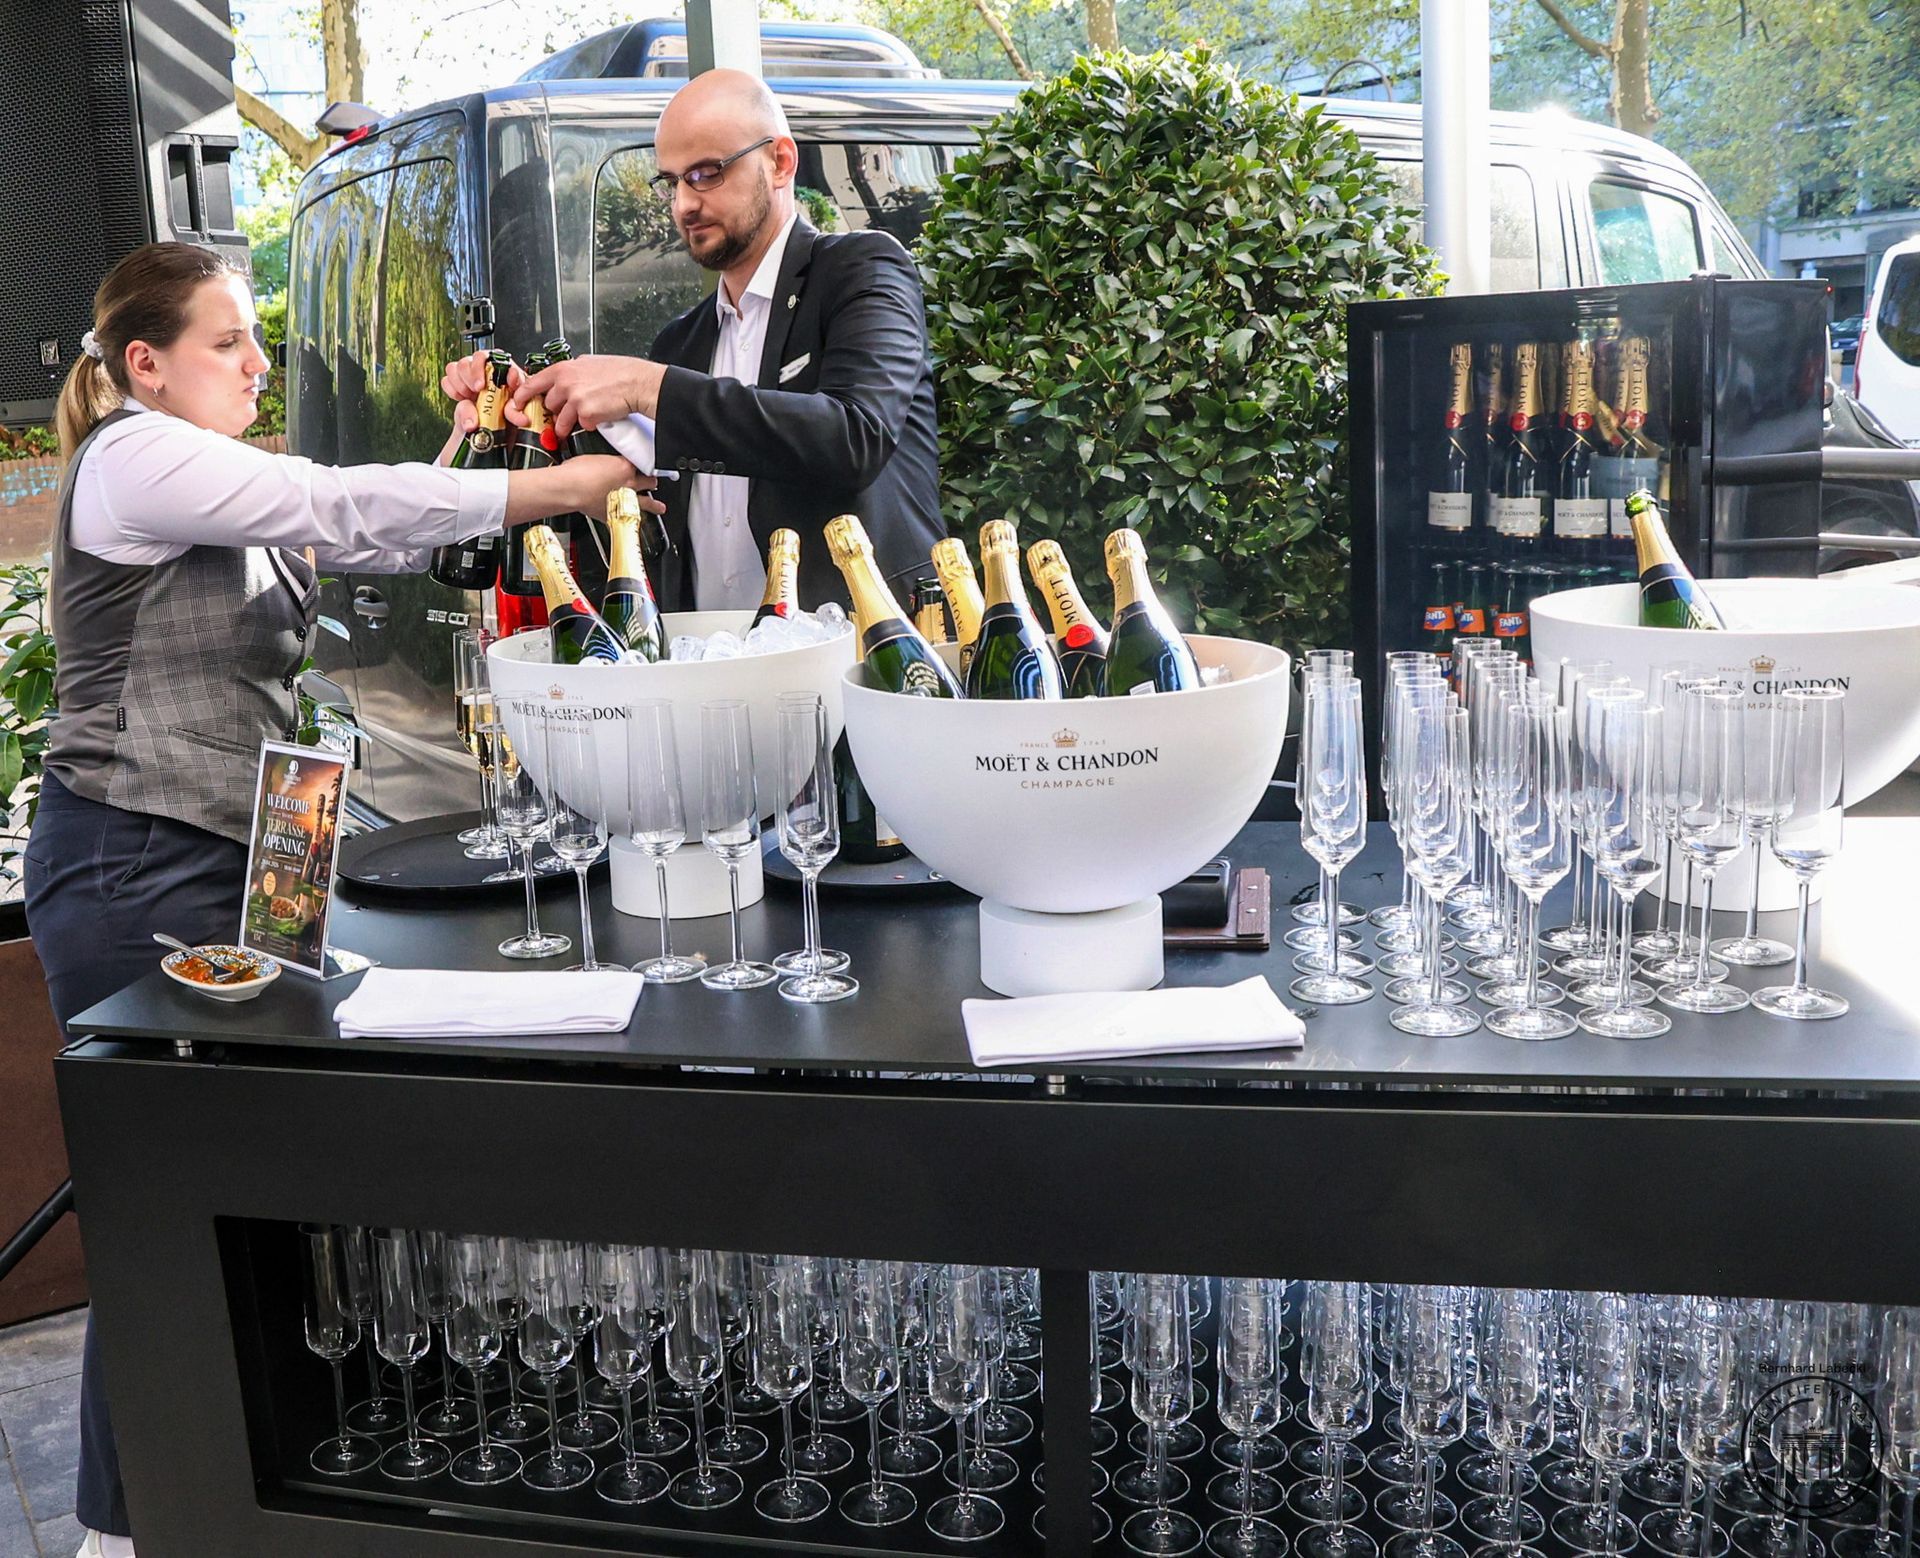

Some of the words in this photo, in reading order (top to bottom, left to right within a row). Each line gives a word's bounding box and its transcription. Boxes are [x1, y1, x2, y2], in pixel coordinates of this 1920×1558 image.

[975, 753, 1030, 772] MOËT
[1036, 756, 1050, 771] &
[1057, 747, 1159, 771] CHANDON
[1021, 777, 1115, 789] CHAMPAGNE
[267, 792, 310, 815] WELCOME
[265, 816, 306, 839] TERRASSE
[263, 832, 306, 857] OPENING
